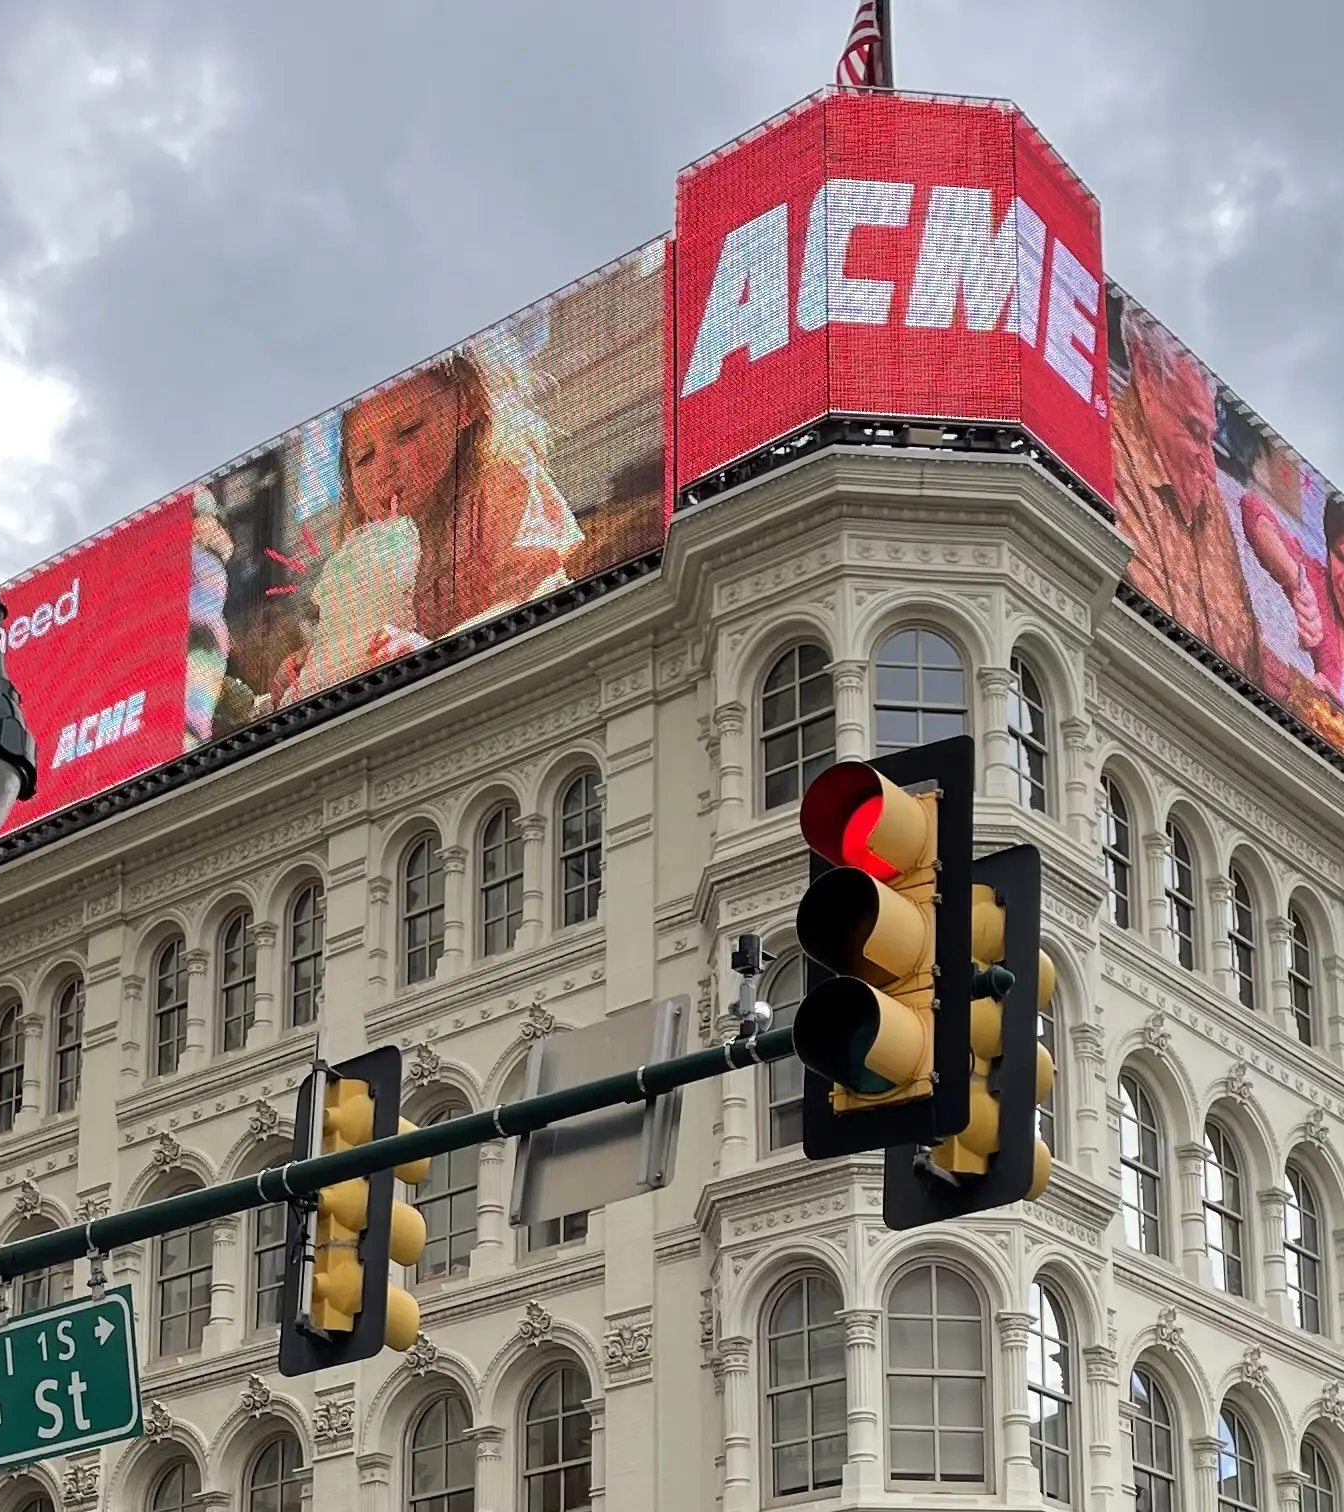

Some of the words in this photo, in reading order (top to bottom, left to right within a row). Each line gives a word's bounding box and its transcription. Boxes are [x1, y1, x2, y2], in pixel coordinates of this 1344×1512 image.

[680, 178, 1100, 403] ACME
[51, 690, 146, 769] ACME
[35, 1371, 91, 1439] St
